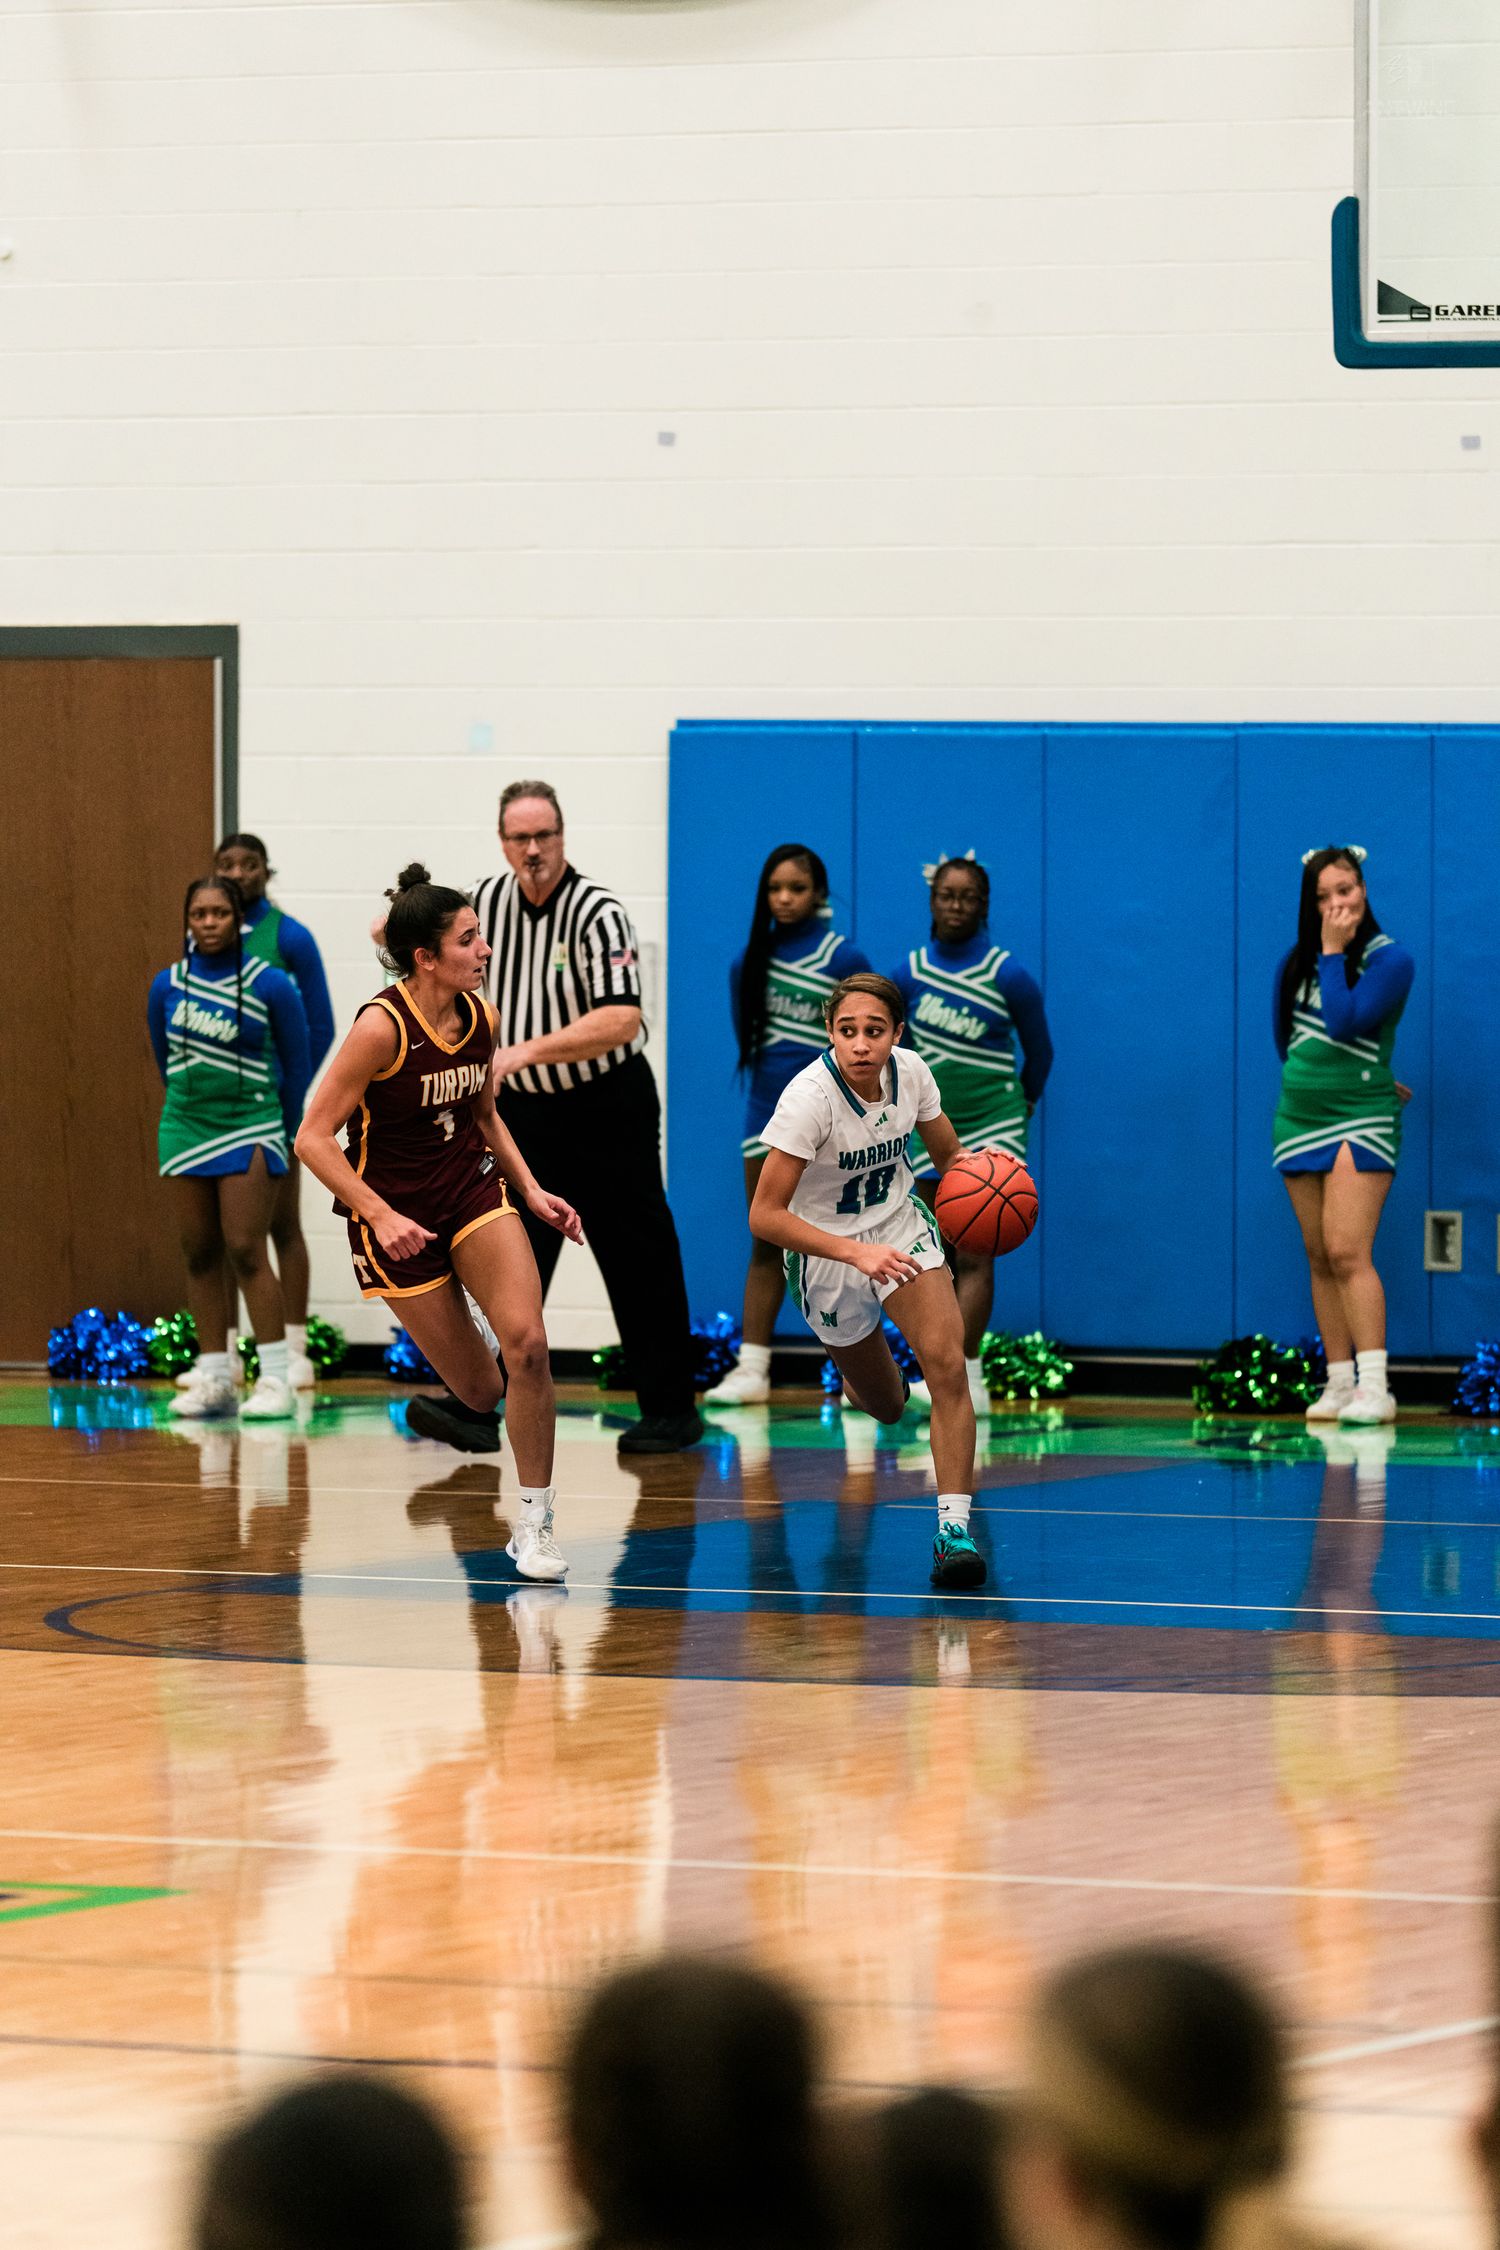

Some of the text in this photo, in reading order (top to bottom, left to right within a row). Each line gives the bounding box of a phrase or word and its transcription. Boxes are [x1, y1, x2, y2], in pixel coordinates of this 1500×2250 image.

[1435, 304, 1500, 316] GARE
[420, 1063, 489, 1107] TURPIN
[836, 1163, 897, 1214] 10
[352, 1252, 373, 1284] T
